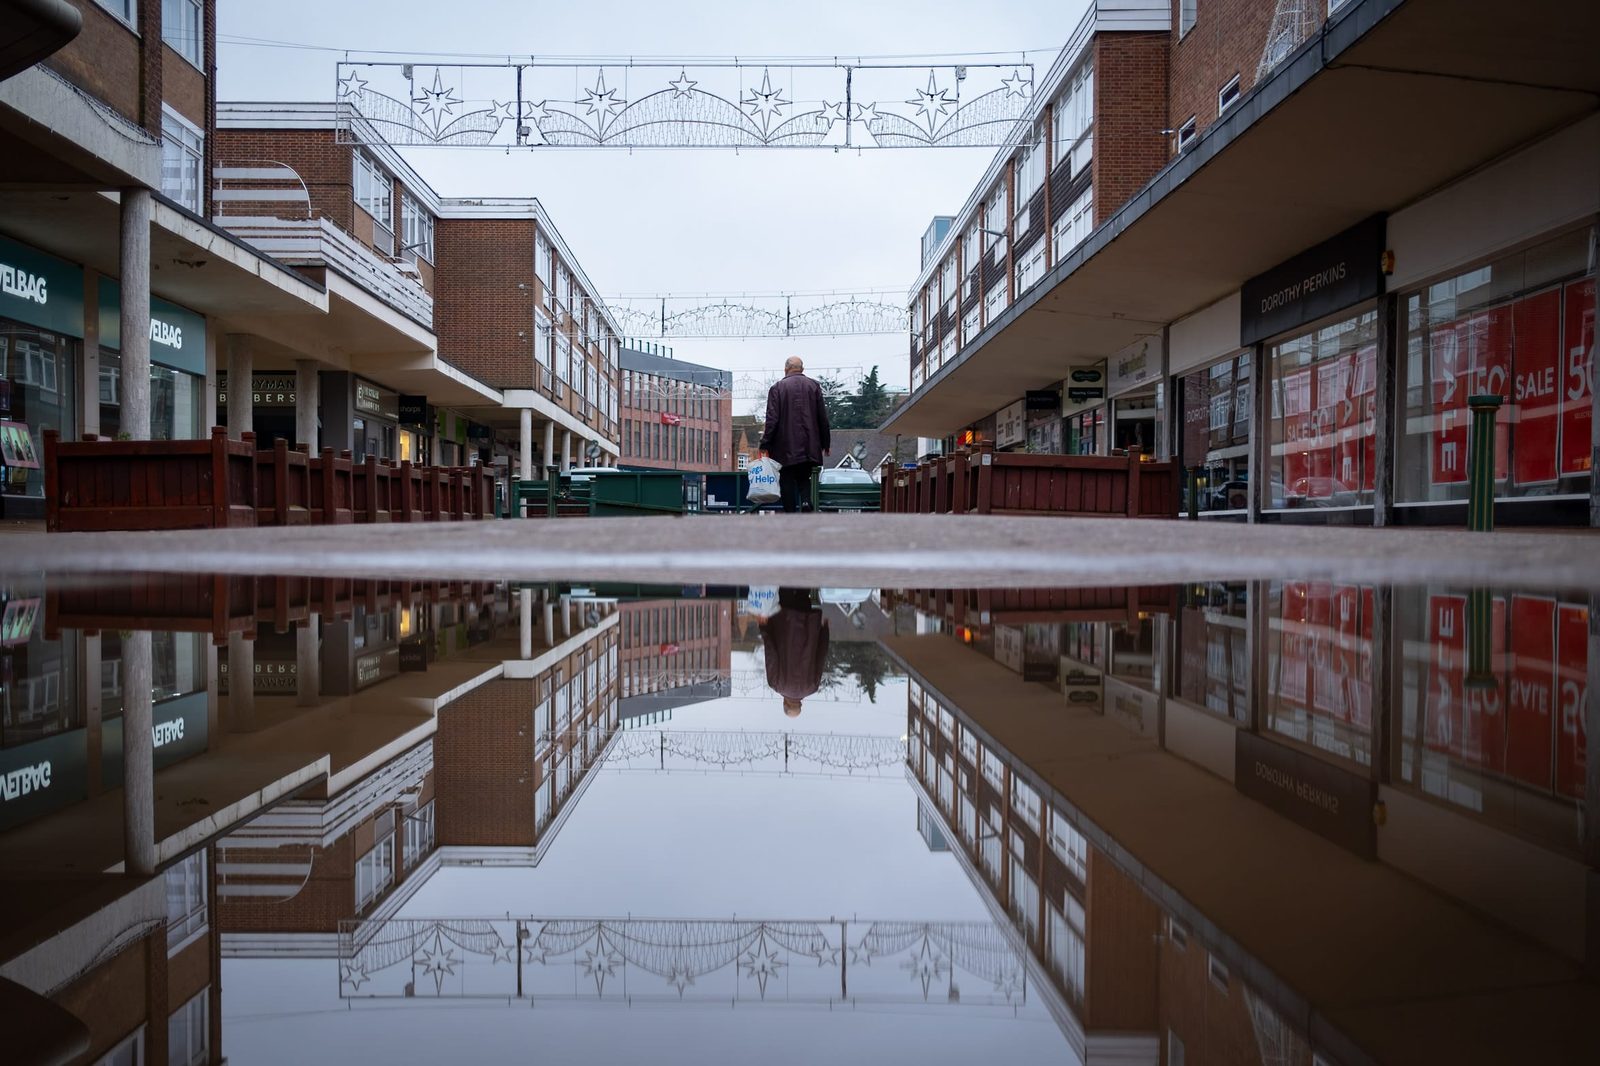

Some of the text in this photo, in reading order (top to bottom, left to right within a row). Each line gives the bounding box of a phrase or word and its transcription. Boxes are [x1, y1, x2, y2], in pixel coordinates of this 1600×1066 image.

[1261, 262, 1346, 314] DOROTHY PERKINS
[1515, 366, 1554, 401] SALE
[219, 393, 296, 403] BBERS
[755, 475, 776, 485] Help
